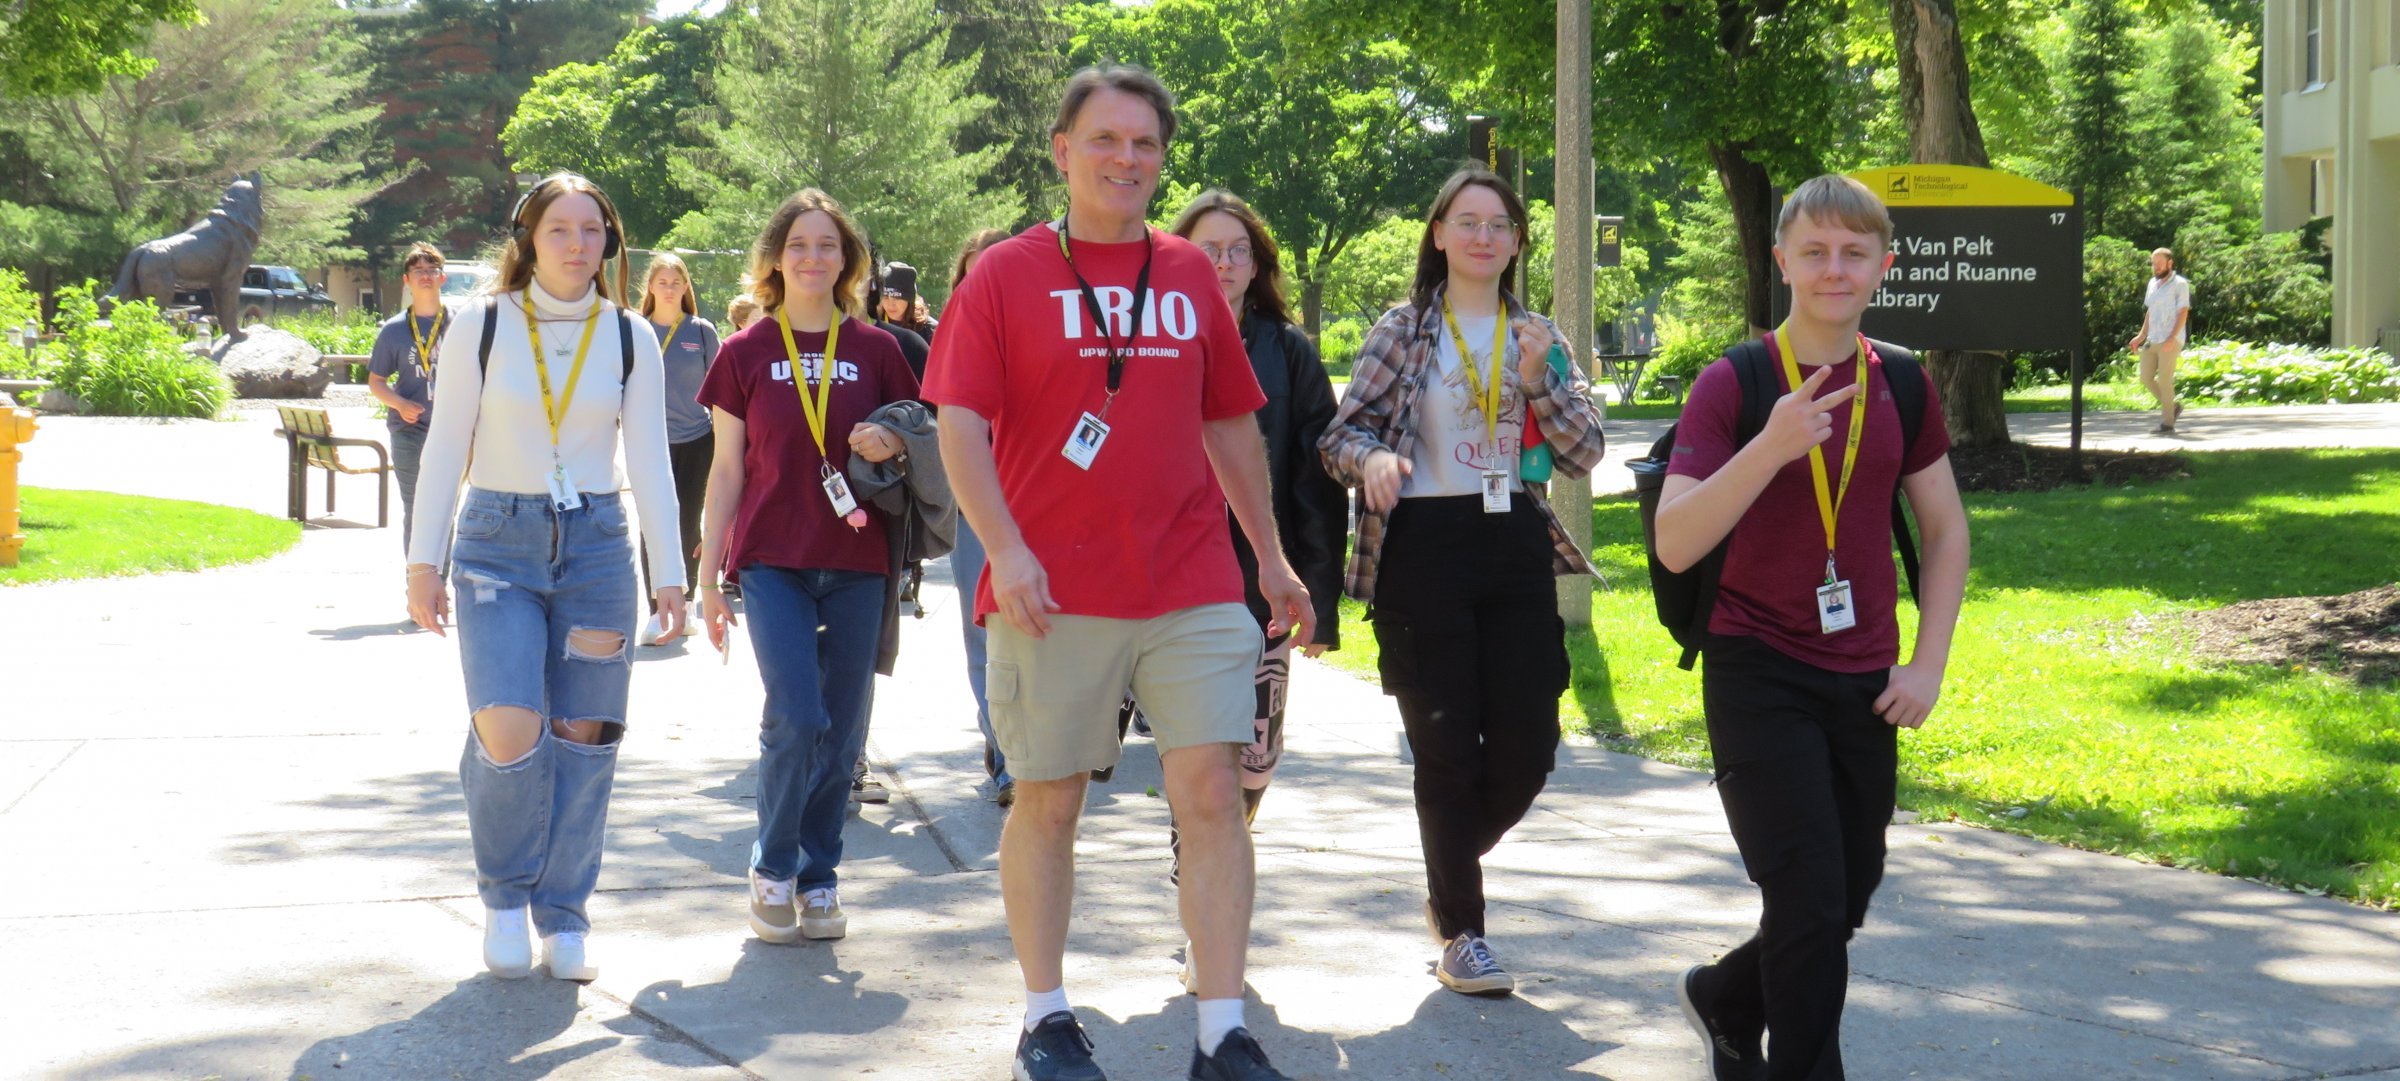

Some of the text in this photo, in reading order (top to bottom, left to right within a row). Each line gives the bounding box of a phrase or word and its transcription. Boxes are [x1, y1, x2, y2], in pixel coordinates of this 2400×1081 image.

[1488, 127, 1496, 149] Tech
[1914, 175, 1951, 184] Michigan
[1914, 183, 1969, 192] Technological
[2050, 213, 2066, 225] 17
[1906, 237, 1946, 256] Van
[1953, 235, 1994, 256] Pelt
[1909, 261, 1949, 281] and
[1956, 262, 2037, 281] Ruanne
[1049, 285, 1198, 340] TRIO
[1079, 347, 1180, 359] UPWRD BOUND
[1454, 436, 1522, 470] QUEE
